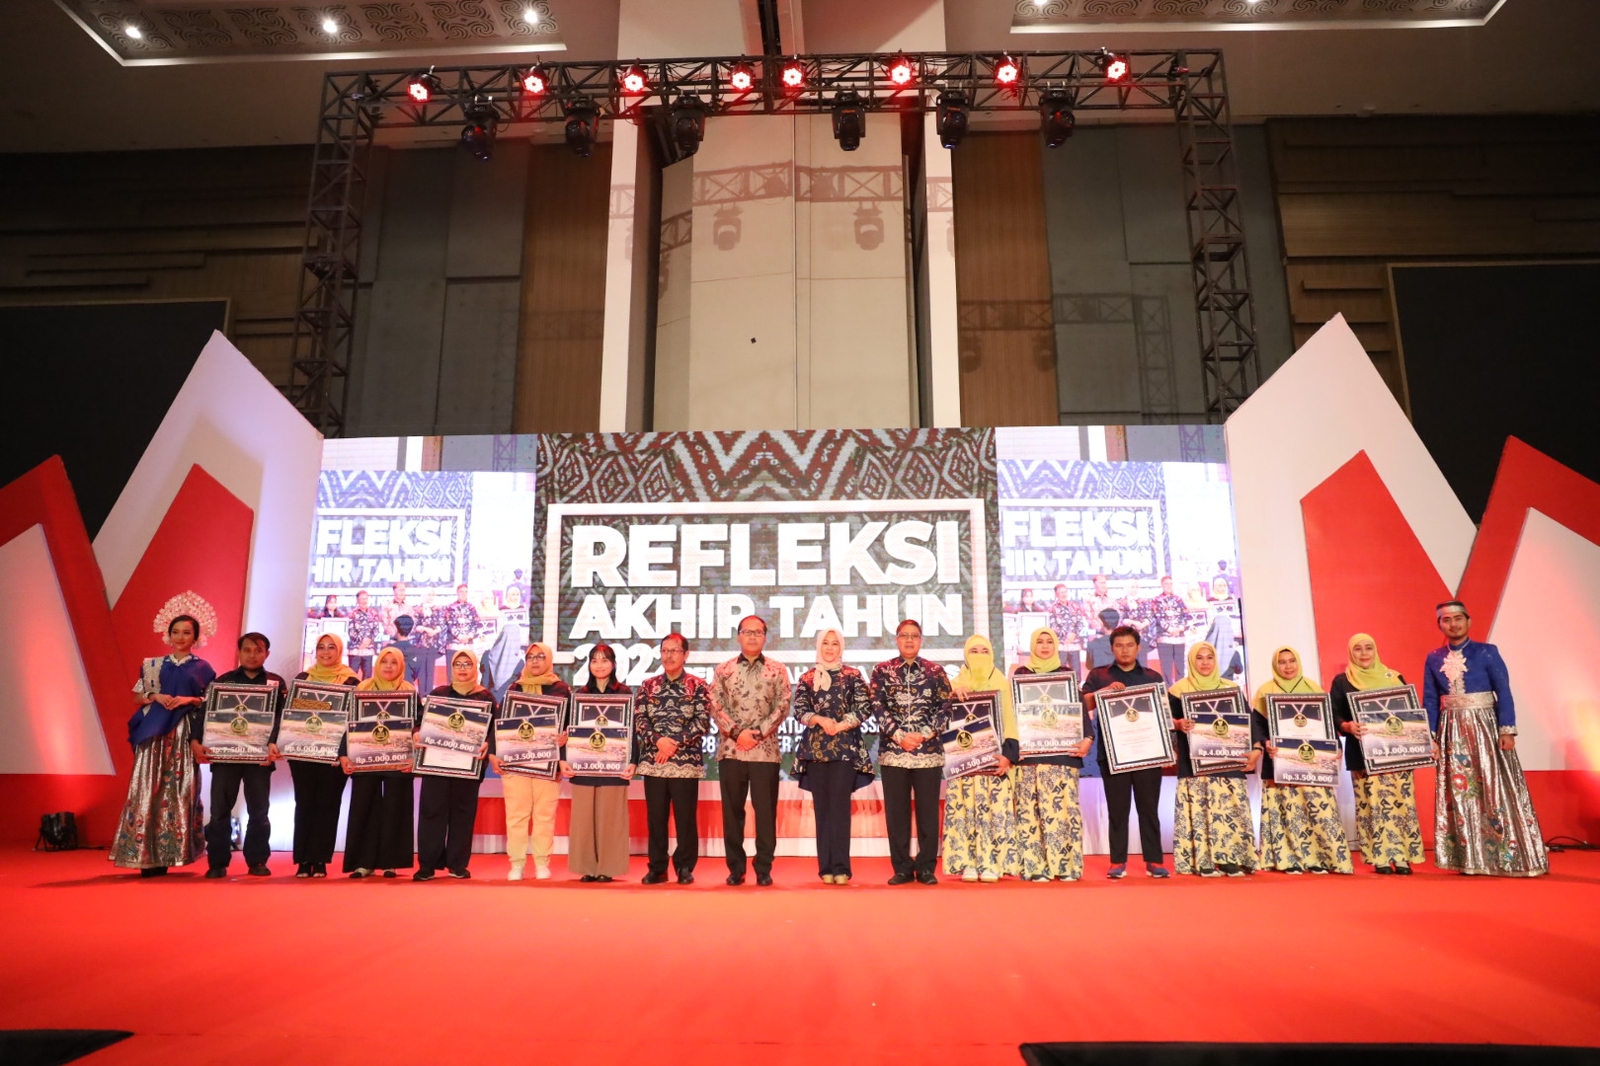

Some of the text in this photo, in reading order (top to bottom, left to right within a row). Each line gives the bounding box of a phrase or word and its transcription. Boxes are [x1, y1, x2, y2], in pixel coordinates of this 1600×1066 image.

[571, 520, 960, 588] REFLEKSI
[1051, 550, 1153, 576] TAHUN
[358, 557, 451, 583] TAHUN
[569, 593, 964, 640] AKHIR TAHUN
[355, 752, 407, 765] Rp.5.000.000
[503, 750, 552, 763] Rp.3.500.000
[572, 762, 621, 771] Rp.3.000.000
[1283, 773, 1334, 783] Rp.3.500.000
